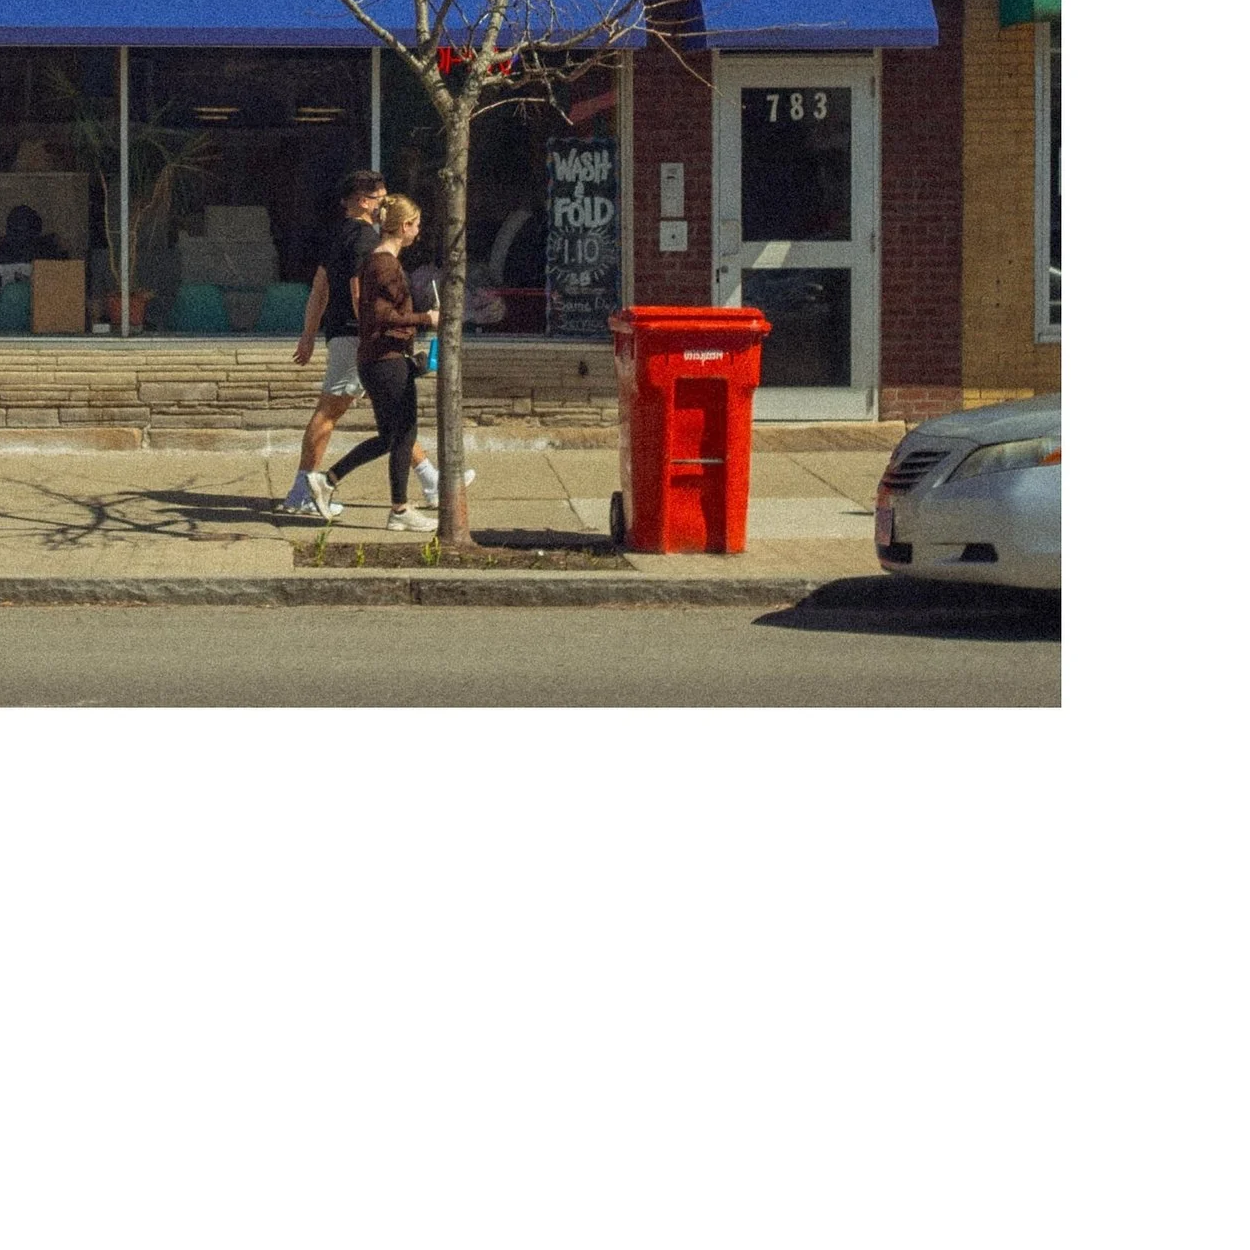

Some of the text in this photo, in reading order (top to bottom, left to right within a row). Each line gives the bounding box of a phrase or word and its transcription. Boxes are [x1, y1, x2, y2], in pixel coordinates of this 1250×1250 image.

[766, 92, 828, 123] 783
[552, 148, 613, 184] WASH
[553, 196, 615, 228] FOLD
